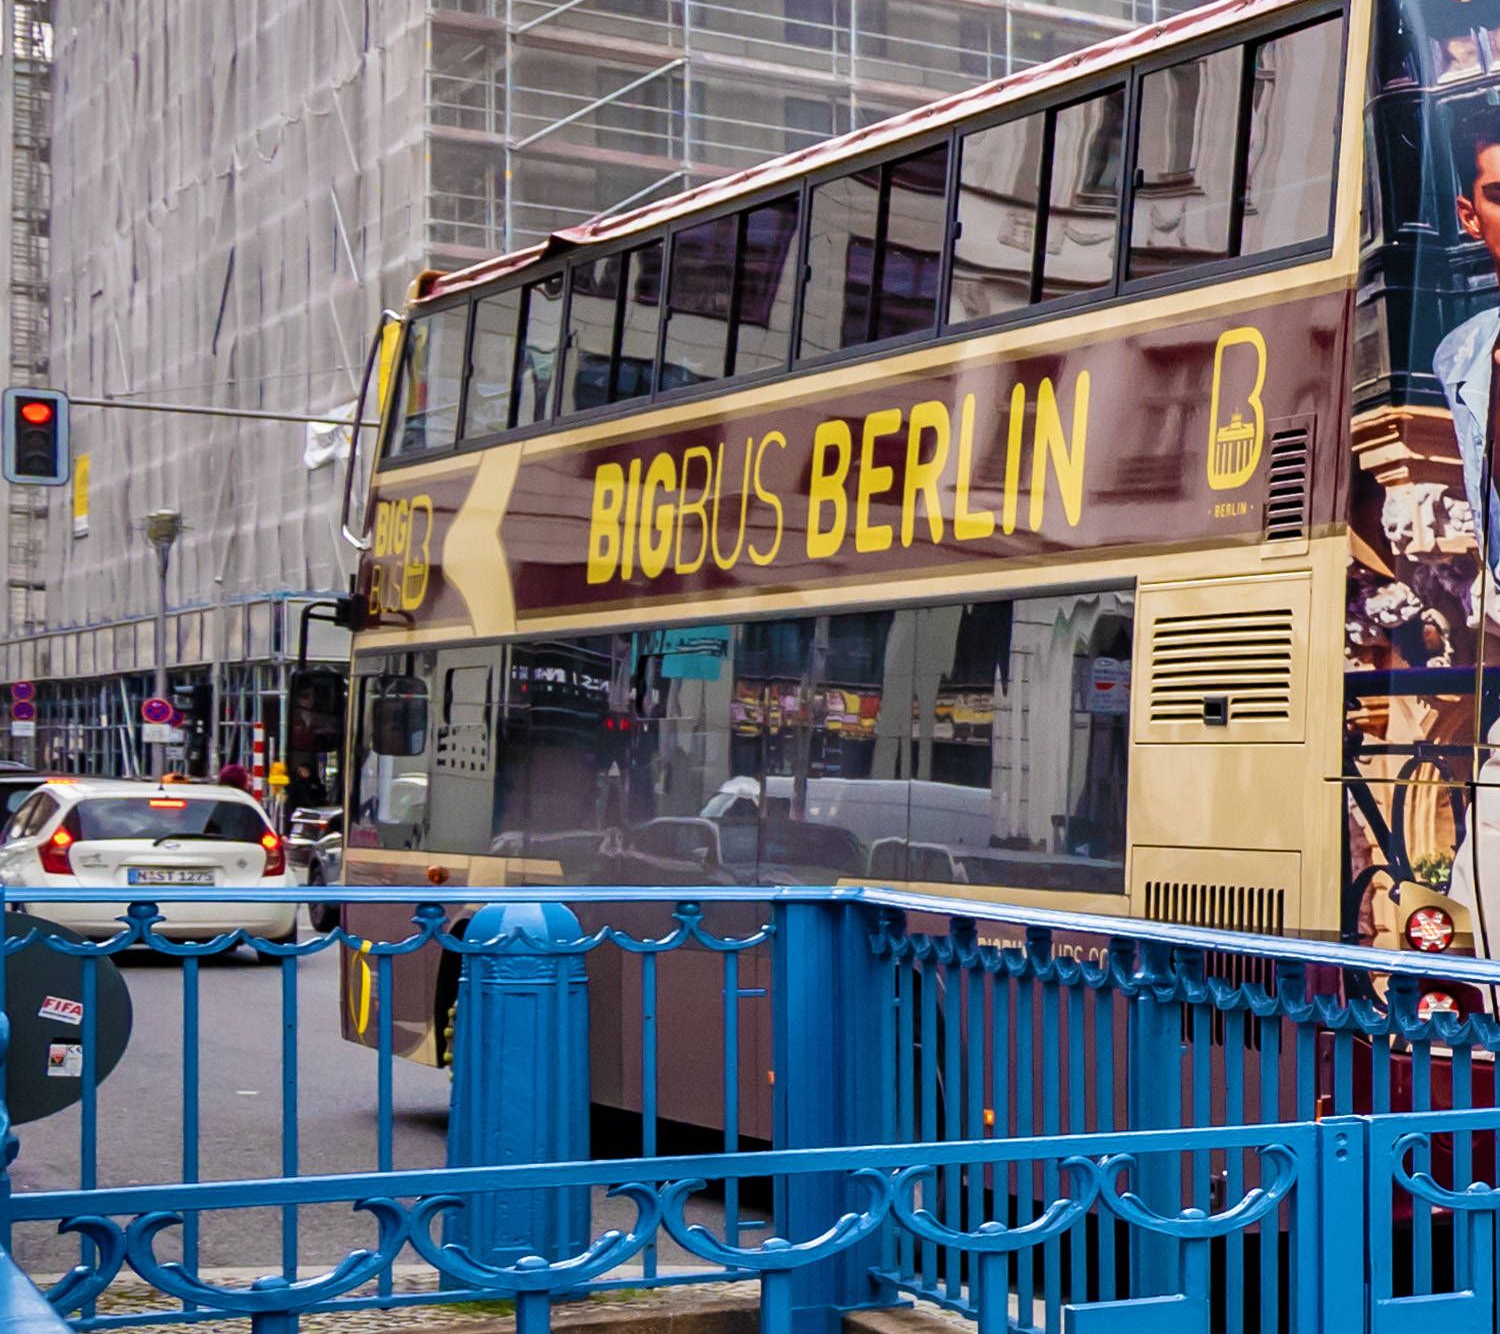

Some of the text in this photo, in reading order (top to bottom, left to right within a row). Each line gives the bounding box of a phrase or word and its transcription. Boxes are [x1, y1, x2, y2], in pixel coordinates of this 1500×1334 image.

[805, 369, 1091, 560] BERLIN
[374, 498, 408, 558] BIG
[1214, 501, 1248, 518] BERLIN
[42, 998, 83, 1016] FIFA
